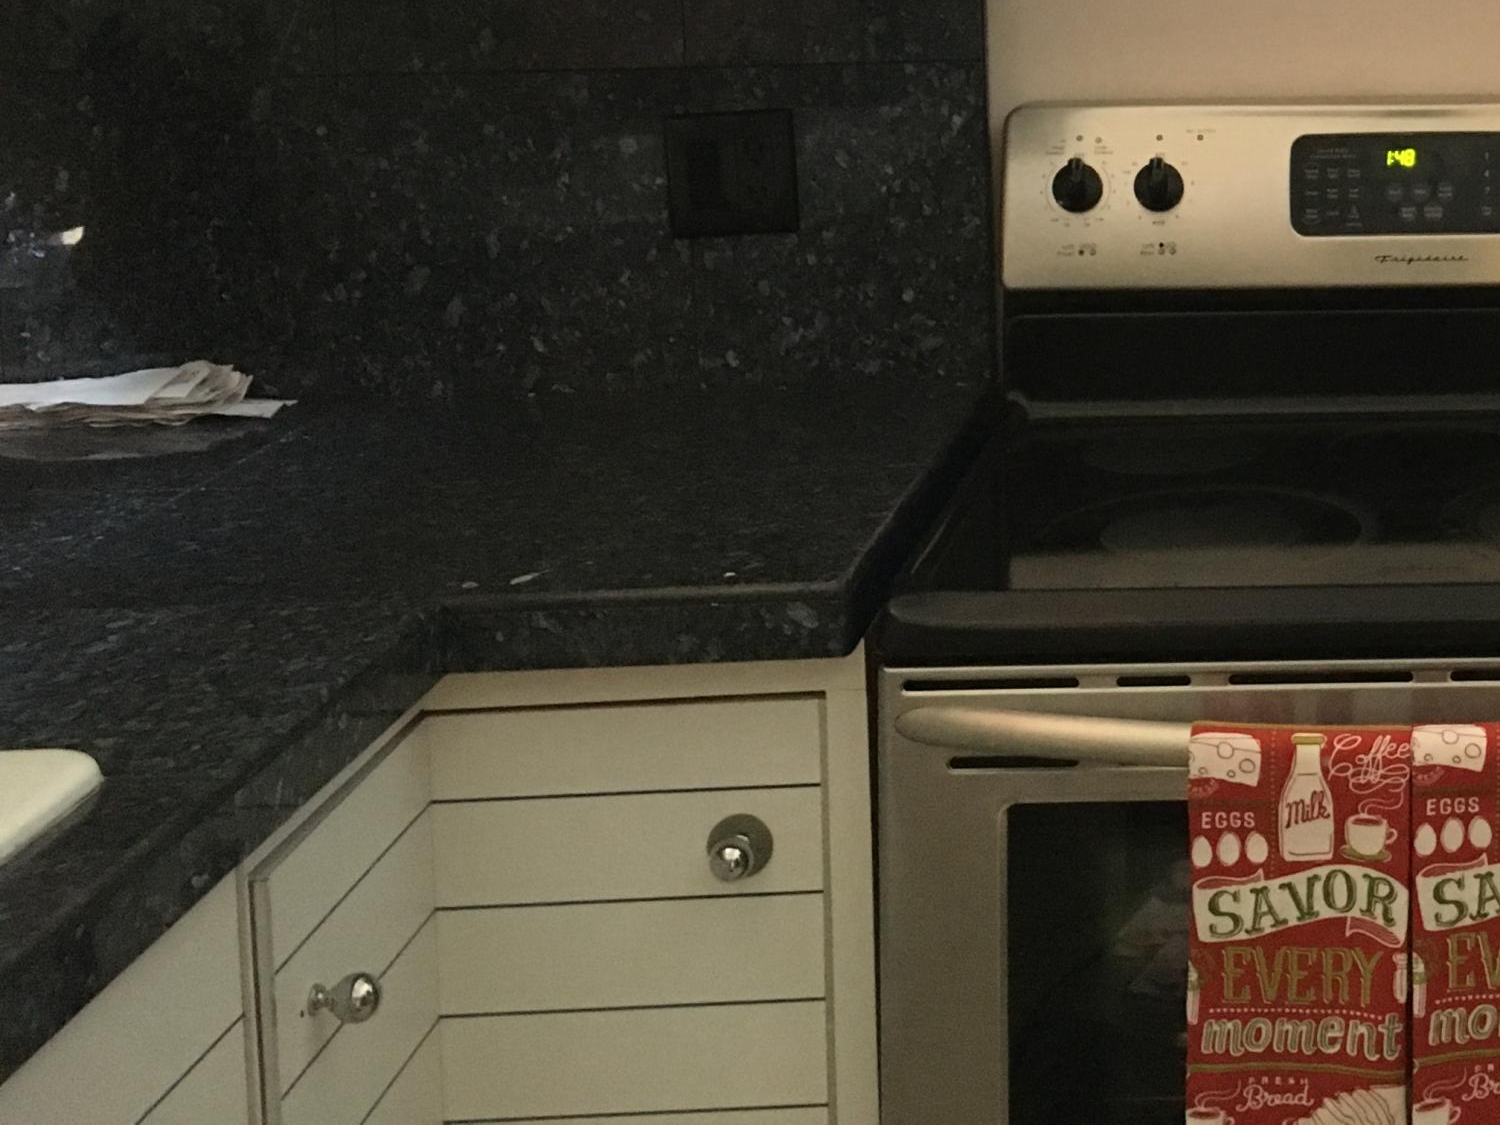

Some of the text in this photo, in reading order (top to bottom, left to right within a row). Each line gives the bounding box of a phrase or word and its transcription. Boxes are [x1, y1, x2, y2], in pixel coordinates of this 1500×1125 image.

[1328, 733, 1411, 785] Coffee
[1201, 811, 1256, 829] EGGS
[1284, 789, 1332, 829] Milk
[1426, 796, 1480, 816] EGGS
[1207, 868, 1399, 939] SAVOR
[1221, 945, 1385, 1008] EVERY
[1200, 1011, 1404, 1062] moment
[1236, 1079, 1316, 1113] Bread
